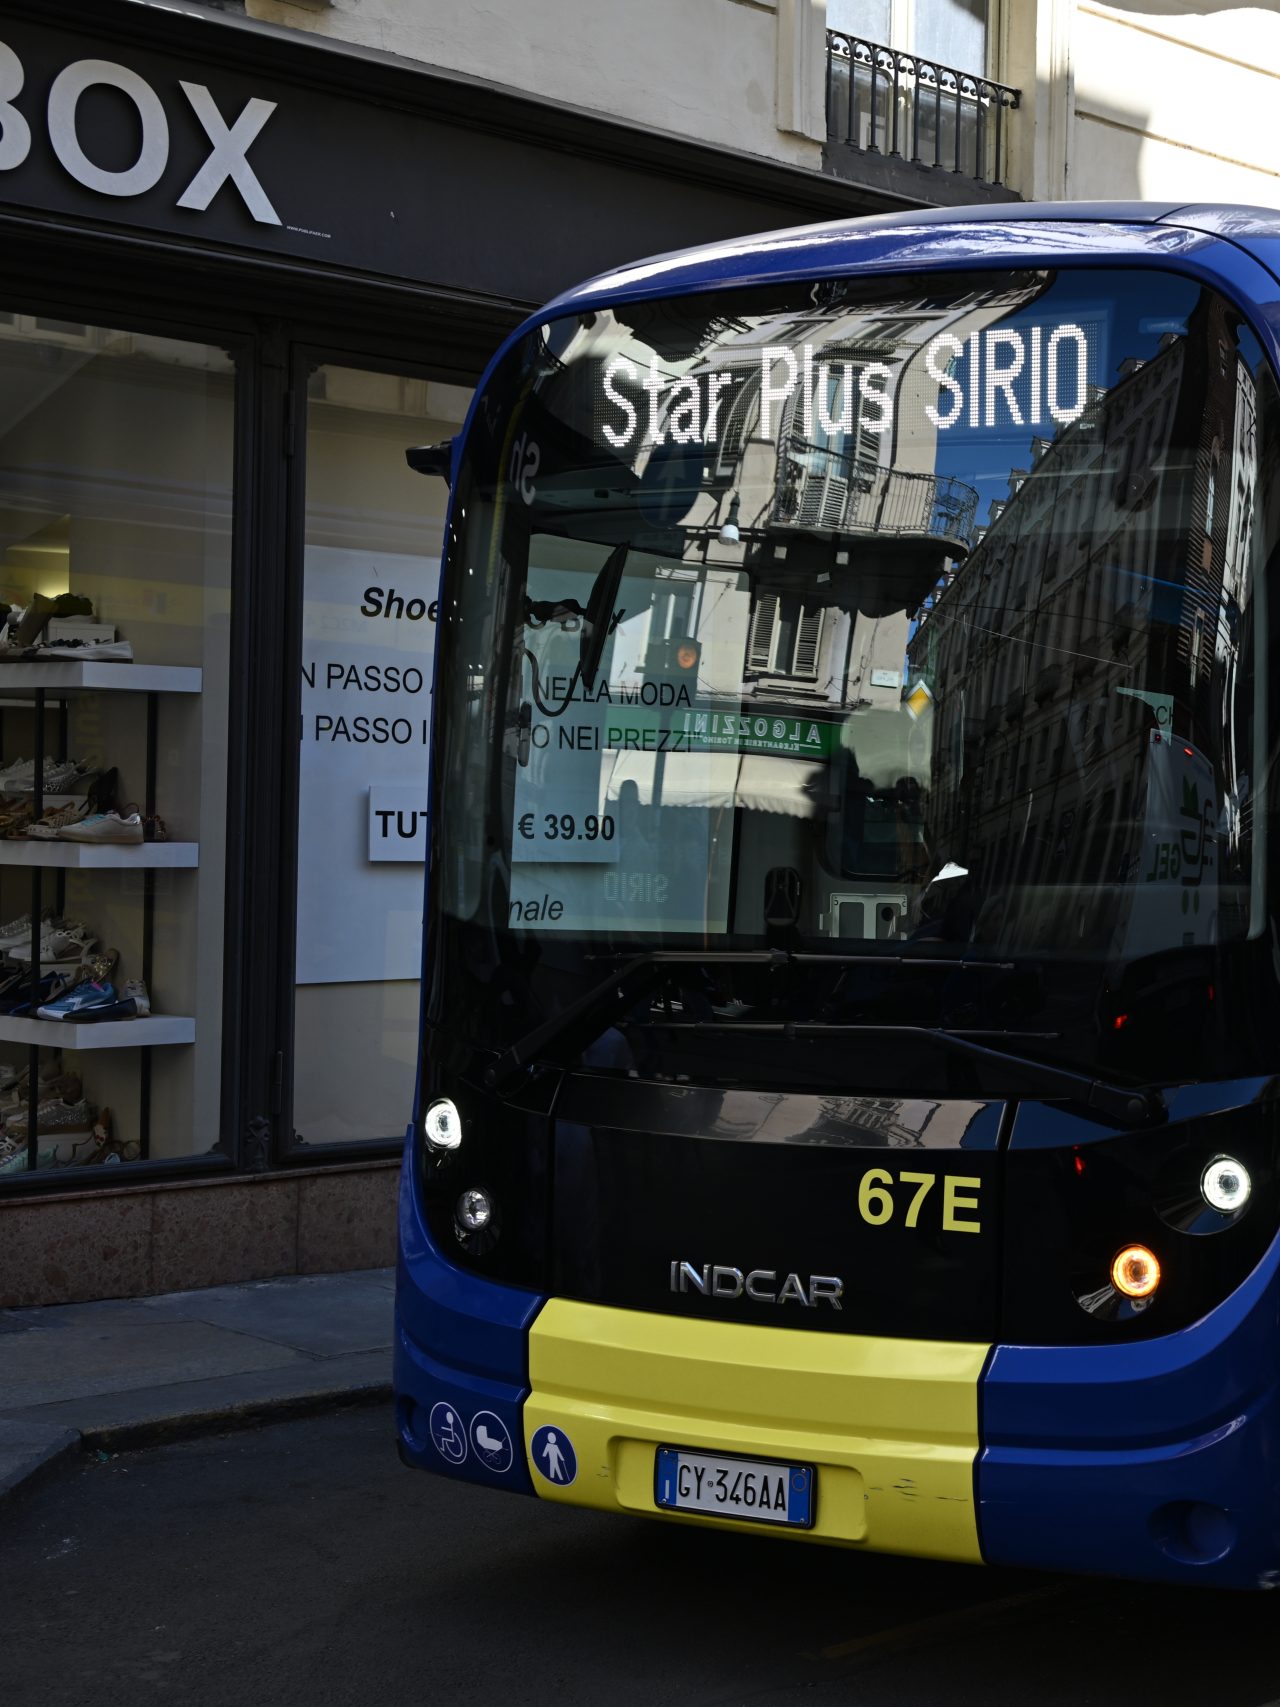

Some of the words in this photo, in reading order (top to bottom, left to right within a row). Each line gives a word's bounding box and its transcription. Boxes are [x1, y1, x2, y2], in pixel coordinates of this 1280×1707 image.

[0, 41, 282, 226] OX
[601, 352, 732, 447] Star
[760, 343, 893, 440] Plus
[924, 324, 1088, 429] SIRIO
[327, 663, 423, 694] PASSO
[620, 680, 692, 708] MODA
[315, 715, 412, 744] PASSO
[559, 726, 599, 750] NEI
[518, 813, 535, 839] €
[544, 814, 615, 841] 39.90
[858, 1168, 982, 1234] 67E
[670, 1260, 844, 1311] INDCAR
[715, 1468, 787, 1512] 346AA
